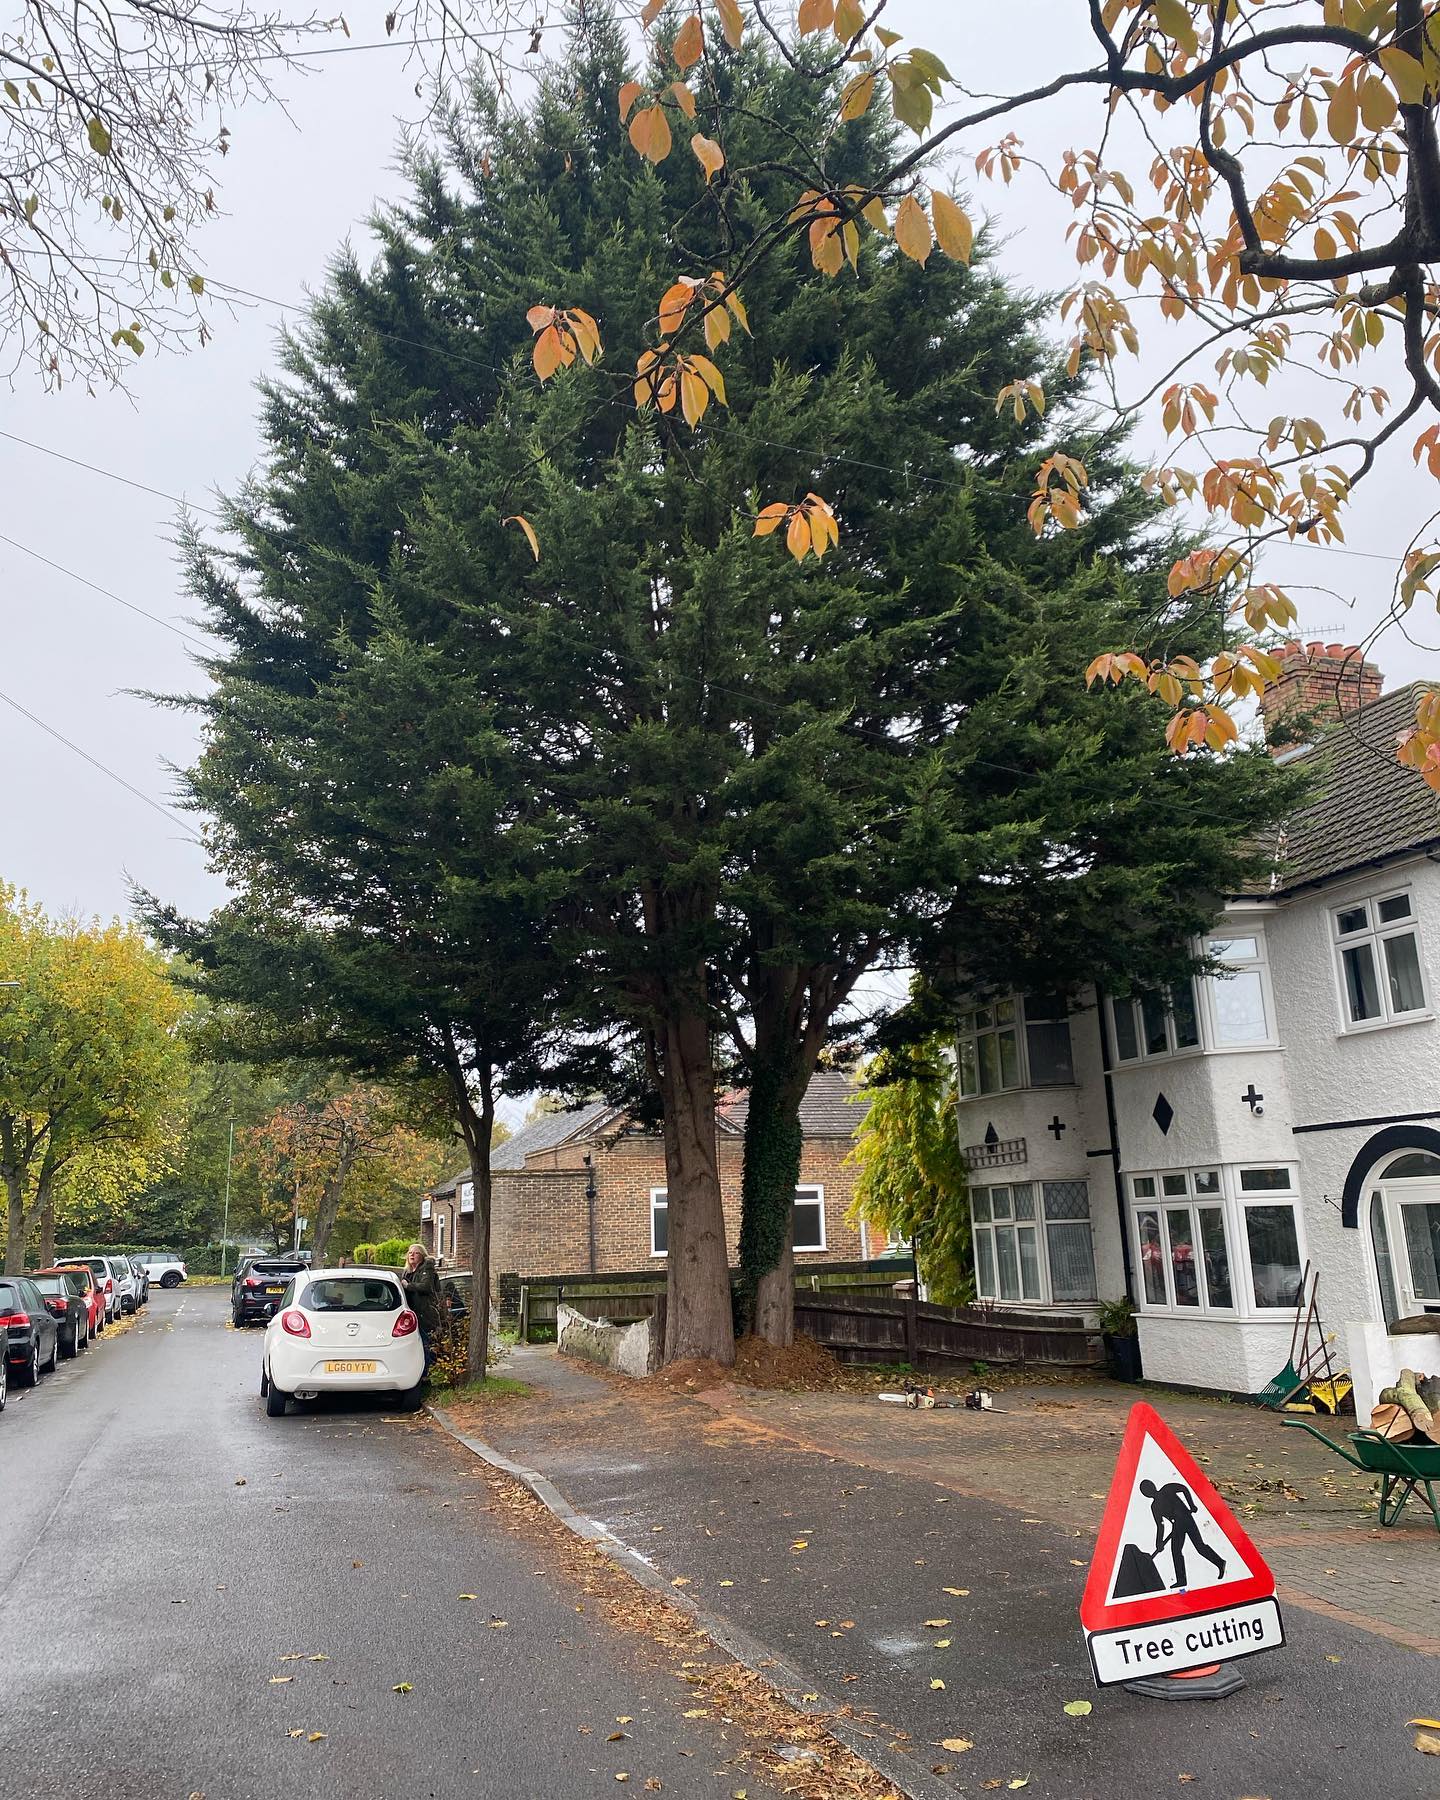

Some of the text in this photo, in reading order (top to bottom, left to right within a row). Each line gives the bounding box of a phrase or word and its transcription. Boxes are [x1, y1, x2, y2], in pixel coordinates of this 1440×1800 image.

[328, 1362, 372, 1372] LG60 YTY
[1115, 1616, 1265, 1665] Tree cutting
